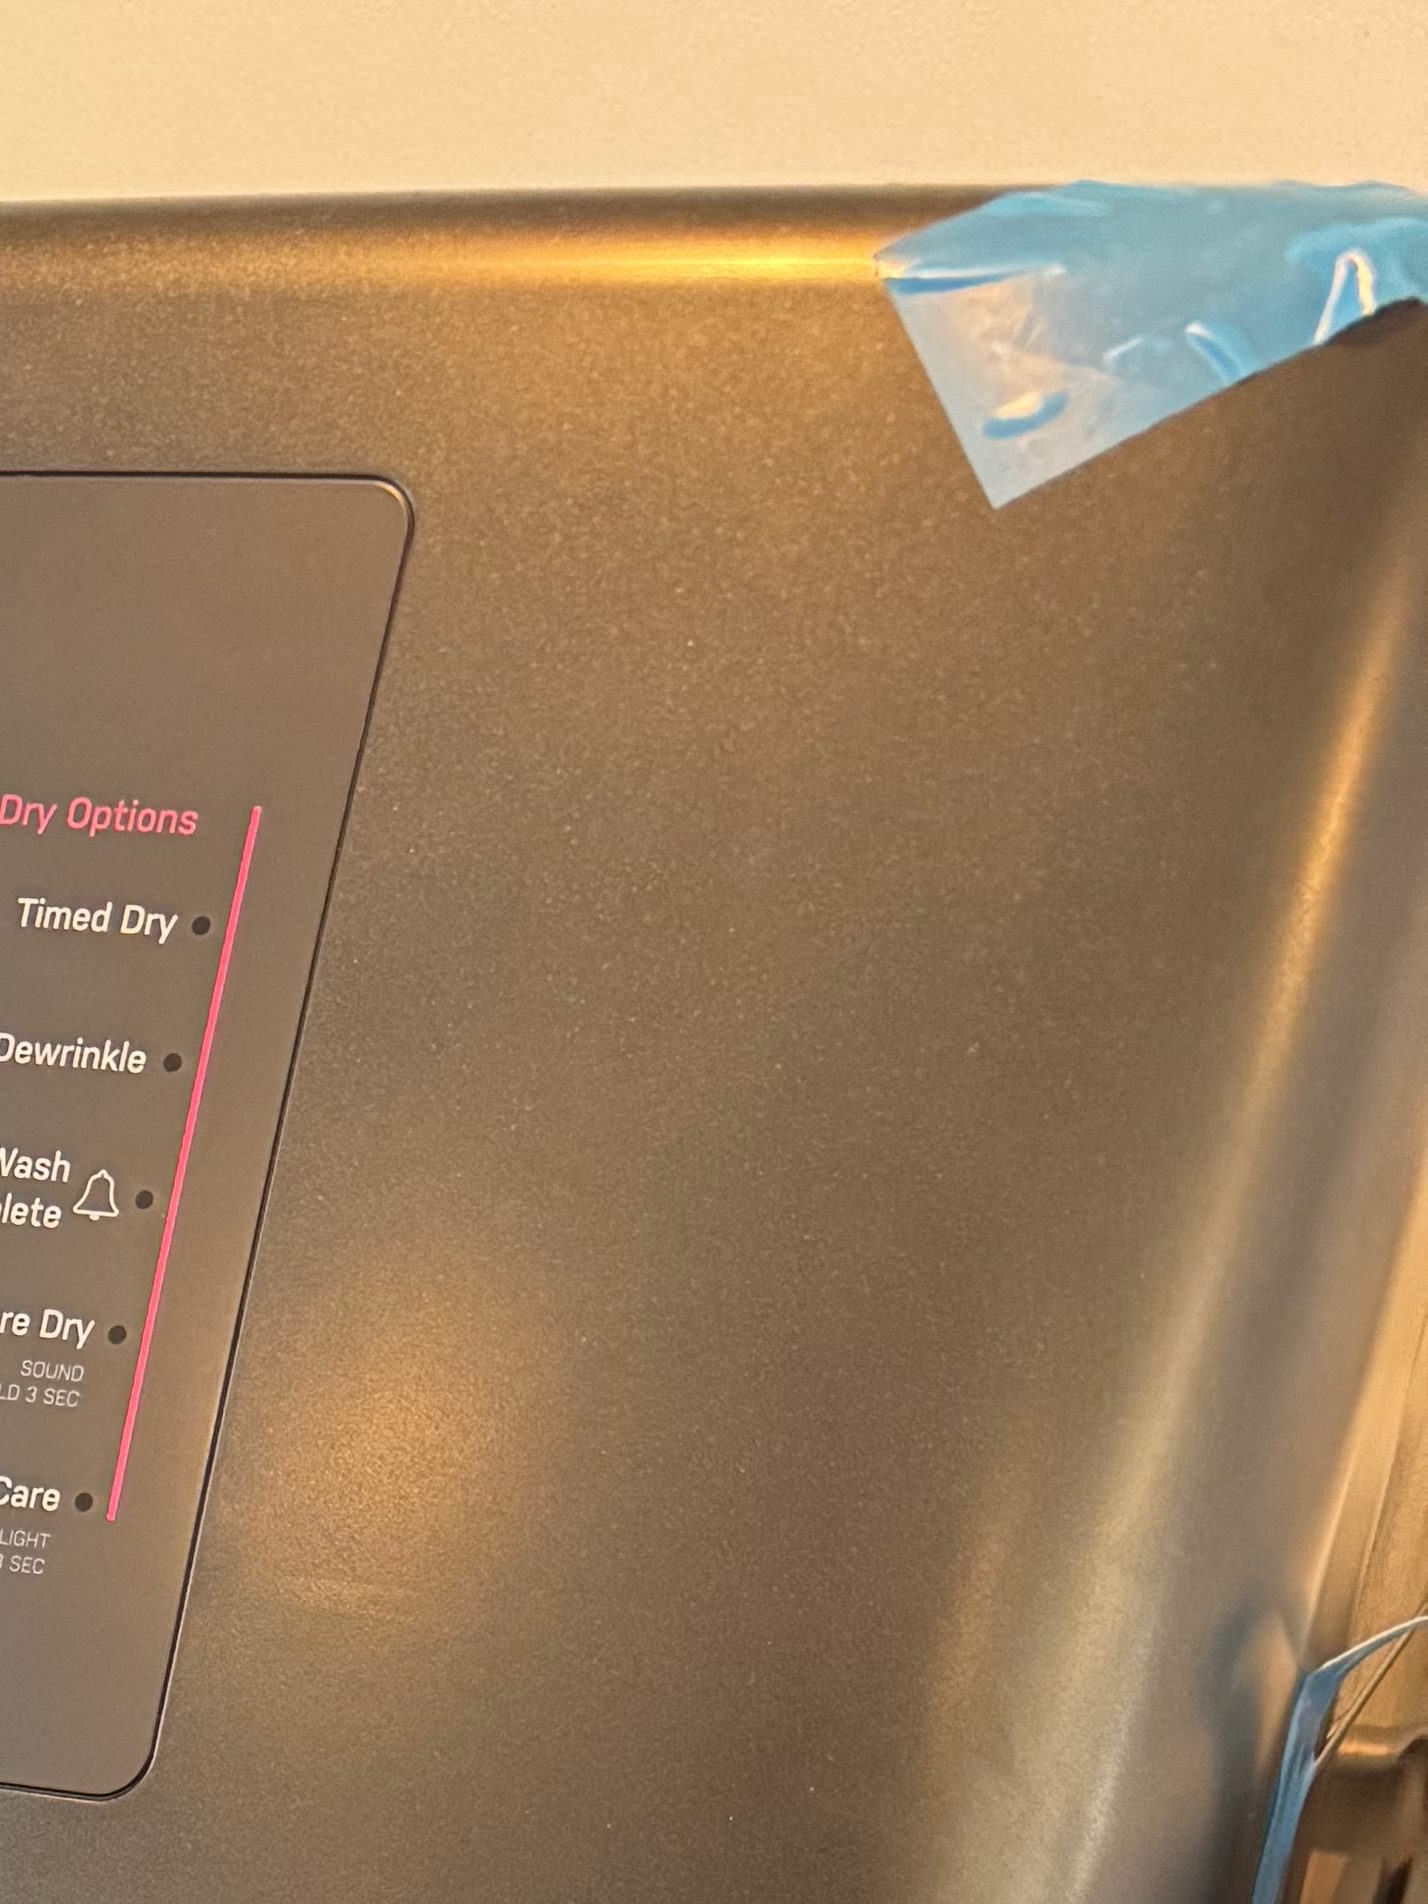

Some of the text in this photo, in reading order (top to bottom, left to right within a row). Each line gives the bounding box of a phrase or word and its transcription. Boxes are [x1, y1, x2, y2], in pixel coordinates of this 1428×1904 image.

[67, 798, 198, 837] Options
[18, 898, 178, 944] Timed Dry
[40, 1309, 95, 1349] Dry
[21, 1360, 84, 1382] SOUND
[26, 1386, 37, 1402] 3
[44, 1388, 80, 1407] SEC
[0, 1529, 50, 1548] LIGHT
[10, 1555, 45, 1574] SEC
